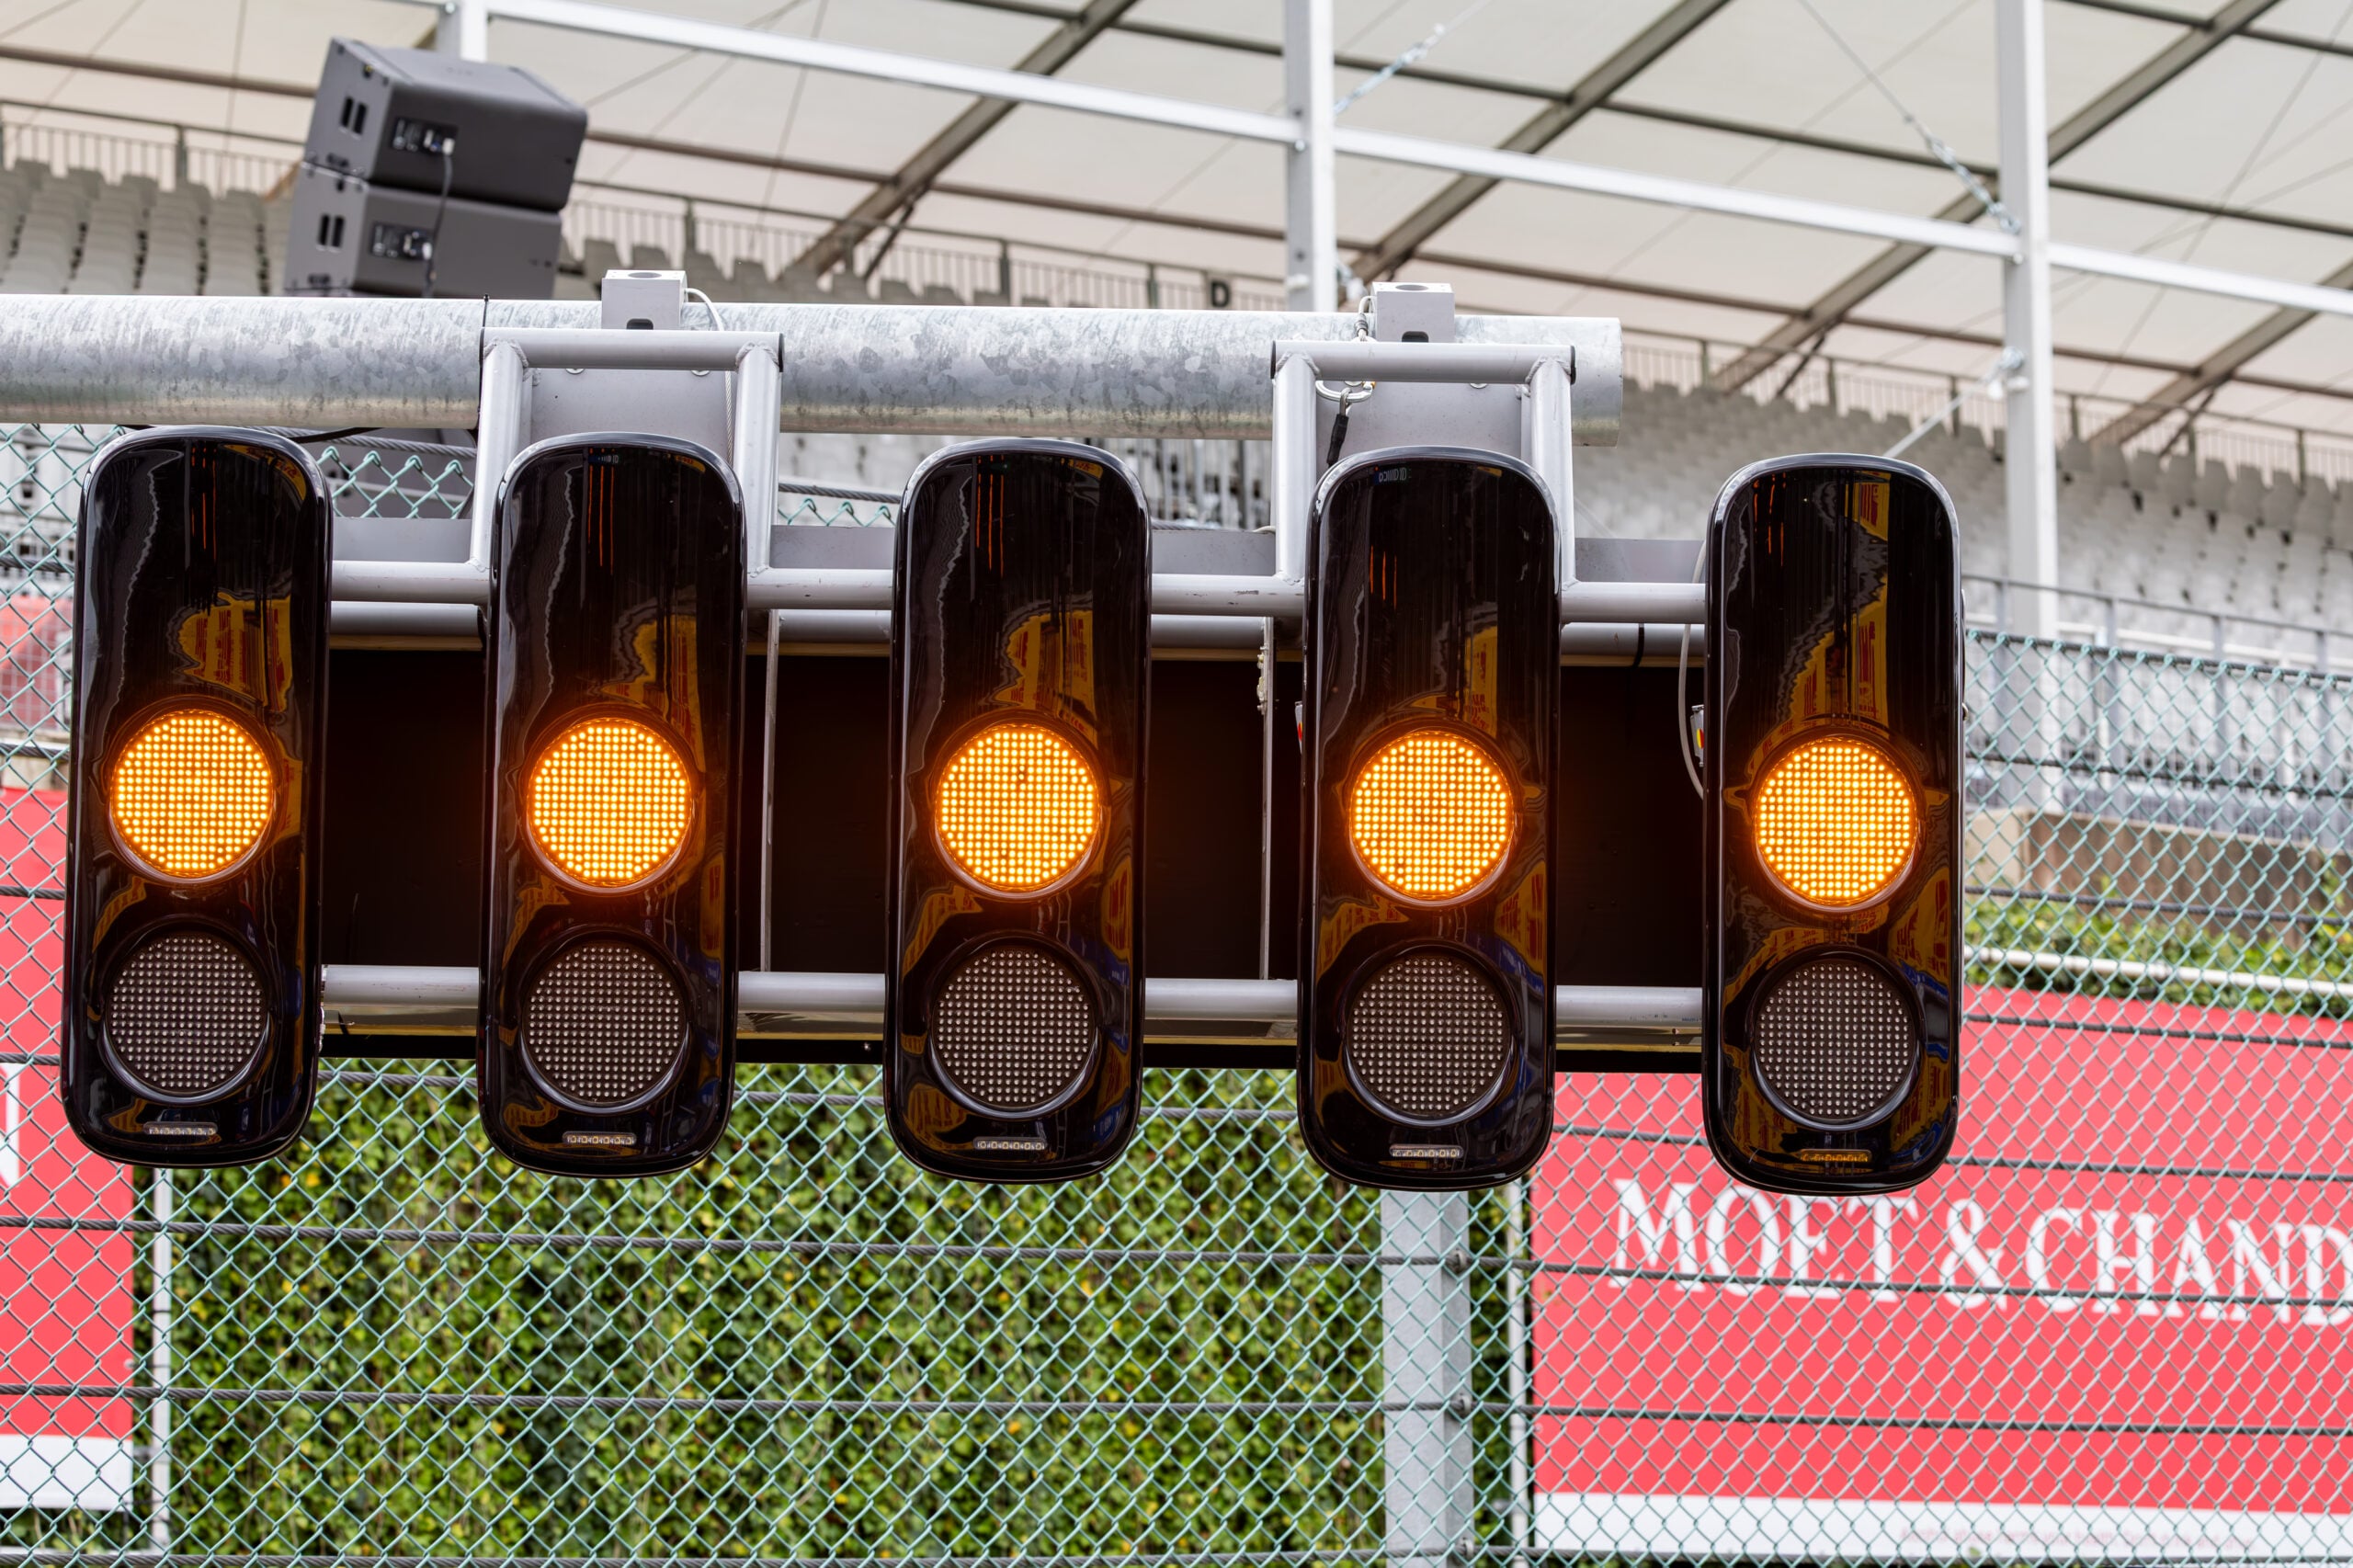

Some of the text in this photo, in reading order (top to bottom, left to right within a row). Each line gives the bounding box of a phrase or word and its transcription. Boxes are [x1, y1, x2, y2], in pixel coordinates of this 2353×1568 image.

[1211, 279, 1232, 308] D
[1939, 1198, 2008, 1312] &
[2025, 1206, 2353, 1326] CHAND
